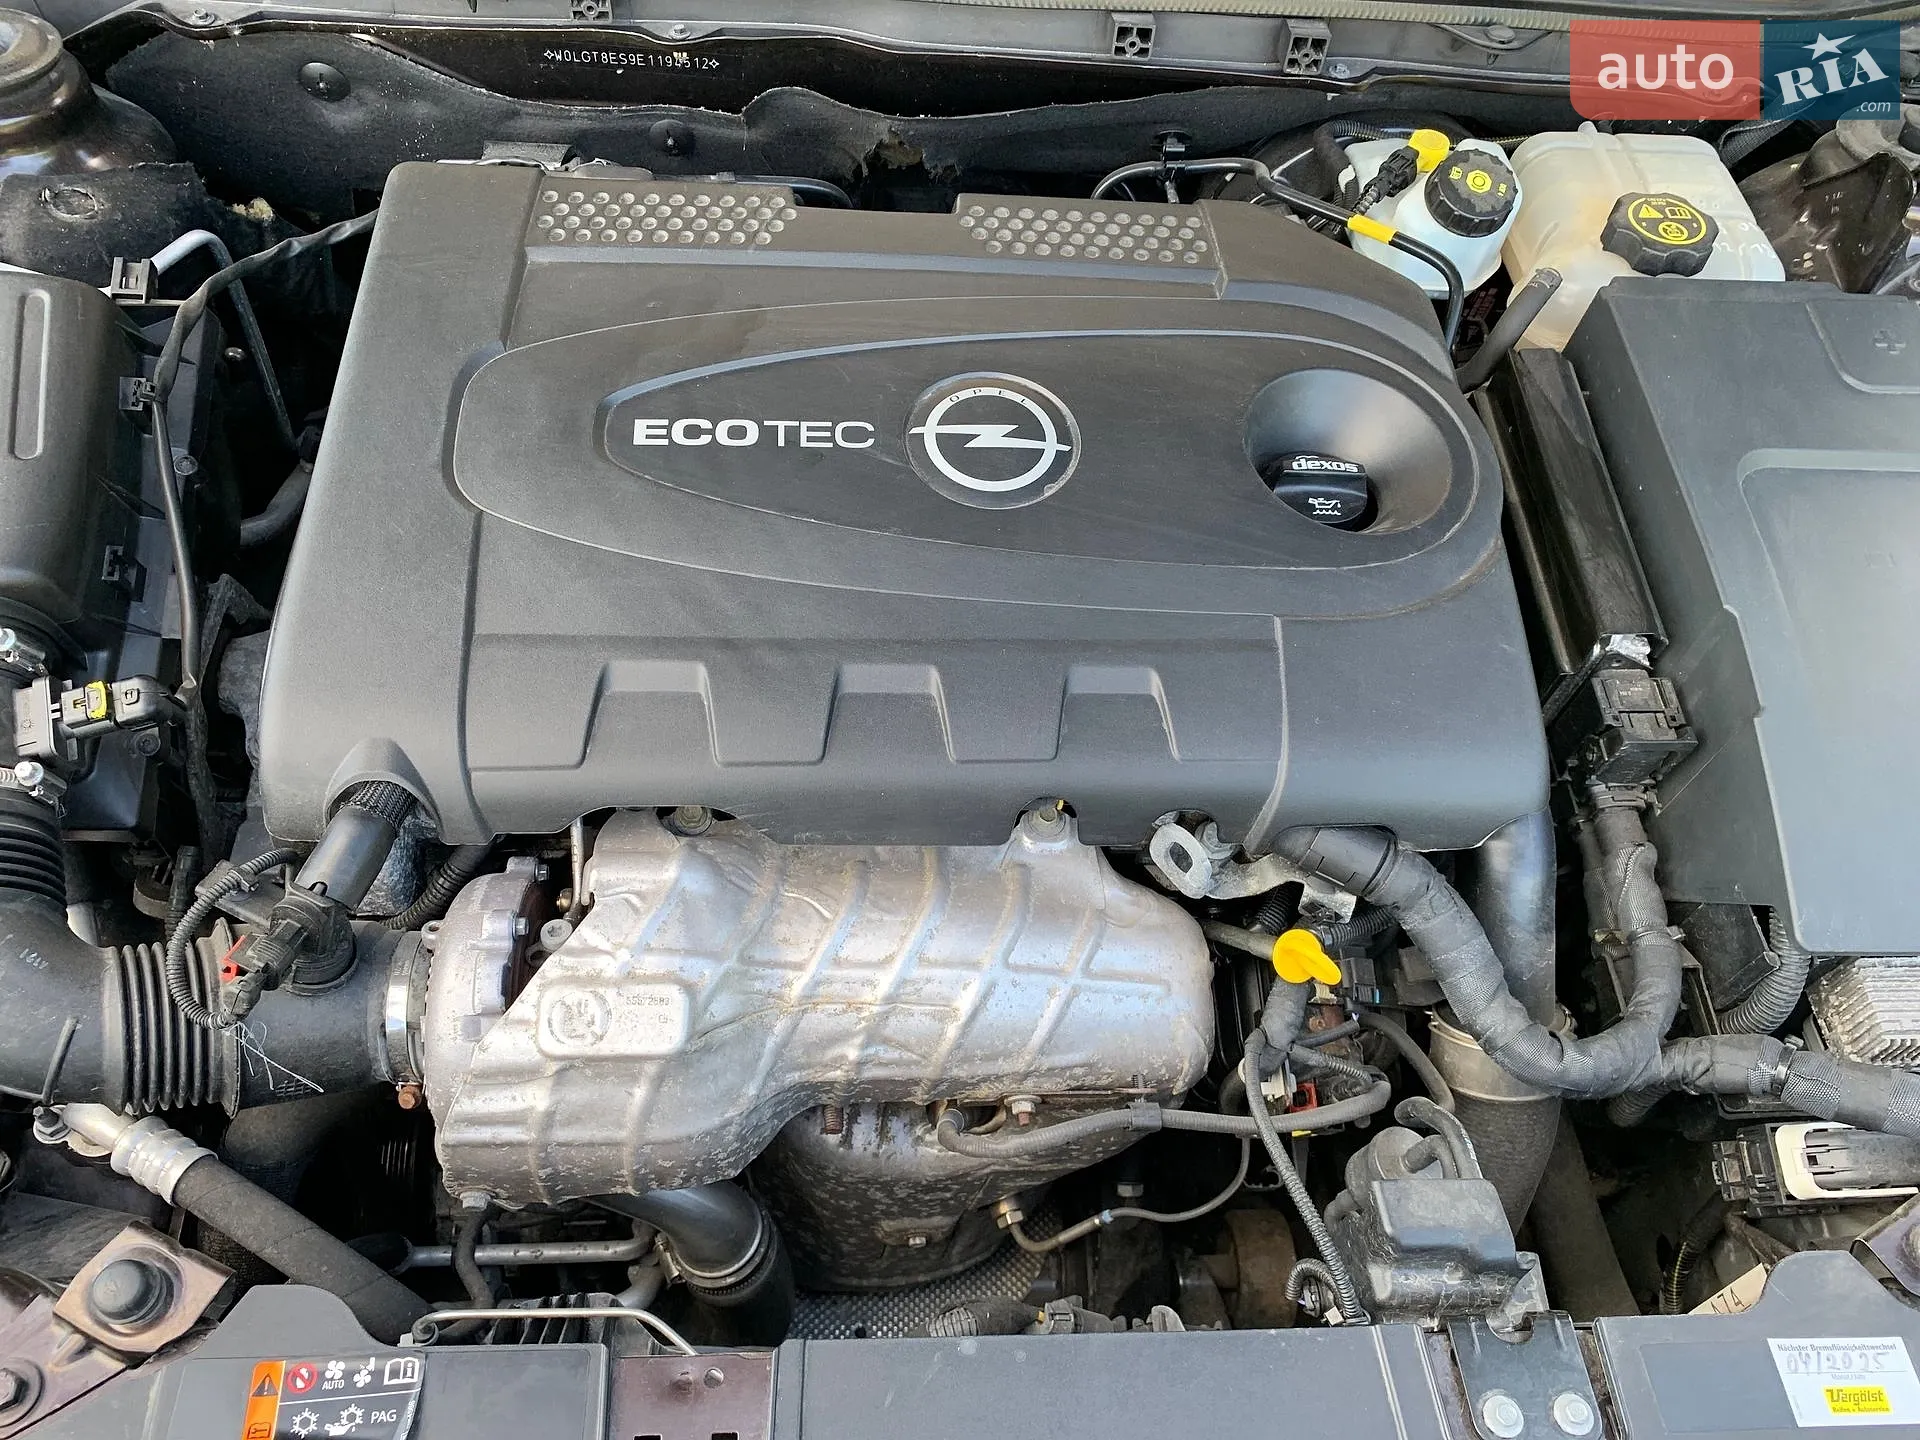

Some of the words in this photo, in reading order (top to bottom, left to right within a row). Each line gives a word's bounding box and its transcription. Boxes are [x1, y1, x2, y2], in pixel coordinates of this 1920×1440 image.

[632, 418, 875, 449] ECOTEC
[1292, 458, 1358, 473] dexos
[321, 1379, 345, 1391] AUTO
[1825, 1388, 1884, 1406] Vergölst
[370, 1409, 397, 1424] PAG
